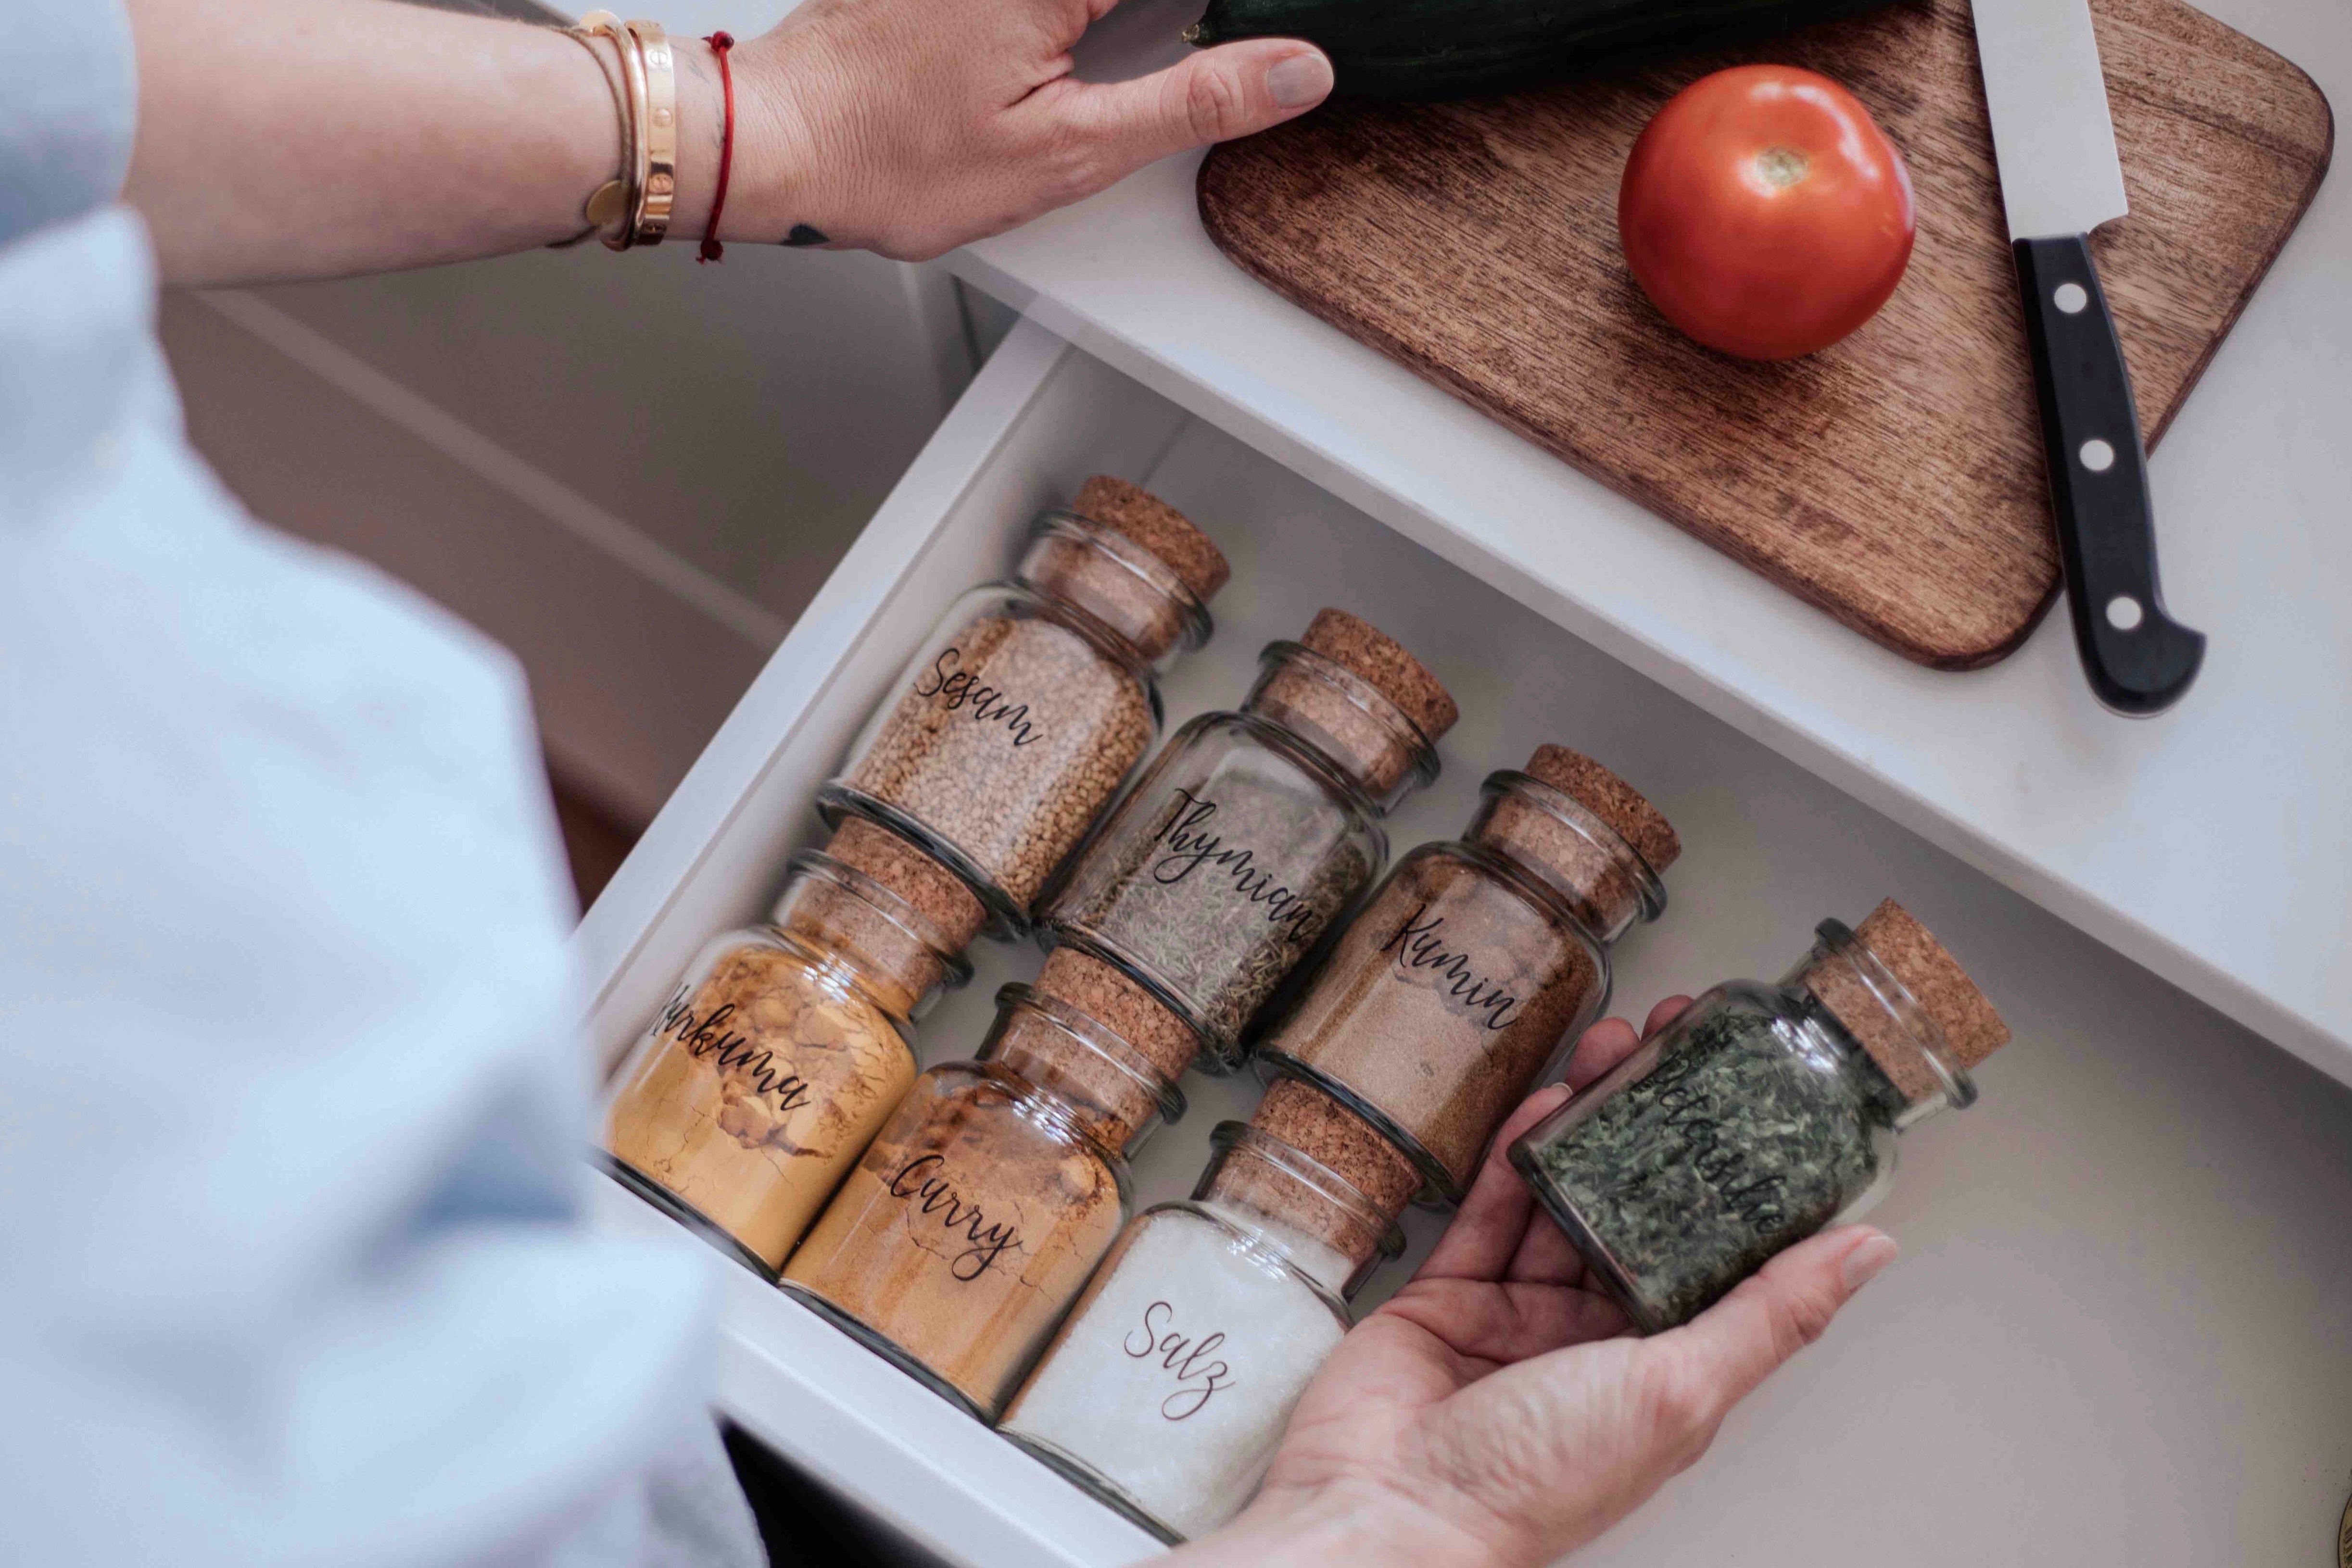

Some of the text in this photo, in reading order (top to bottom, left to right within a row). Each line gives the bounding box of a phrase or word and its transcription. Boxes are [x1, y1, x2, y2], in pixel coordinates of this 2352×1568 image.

[914, 647, 1043, 747] Sesam
[1154, 788, 1319, 943] Thymian
[1380, 903, 1517, 1030] Kumin
[890, 1154, 1024, 1282] Curry
[1124, 1300, 1236, 1421] Salz
